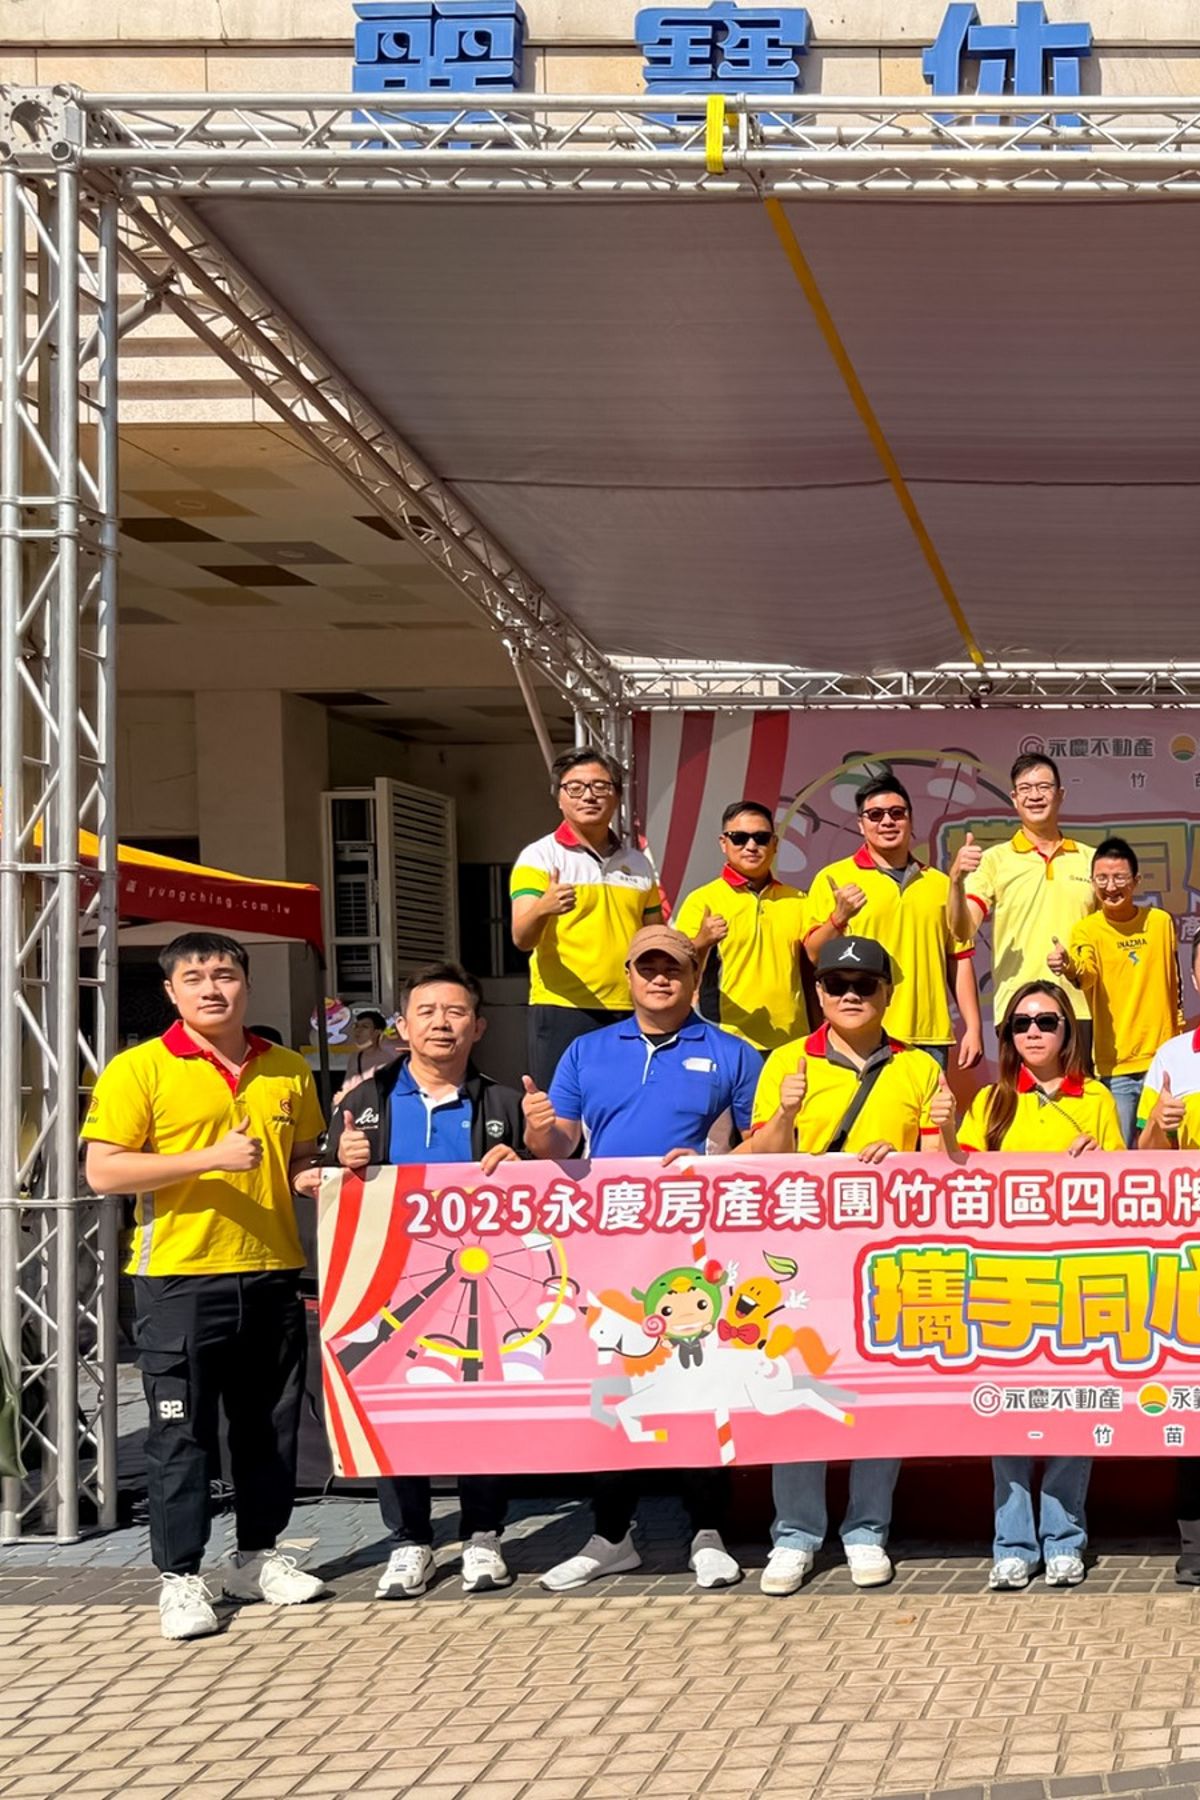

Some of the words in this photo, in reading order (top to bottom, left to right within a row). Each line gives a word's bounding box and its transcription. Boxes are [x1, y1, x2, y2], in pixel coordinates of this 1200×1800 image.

[1048, 737, 1154, 758] 永慶不動產
[159, 1400, 184, 1419] 92
[1004, 1387, 1121, 1411] 永慶不動產
